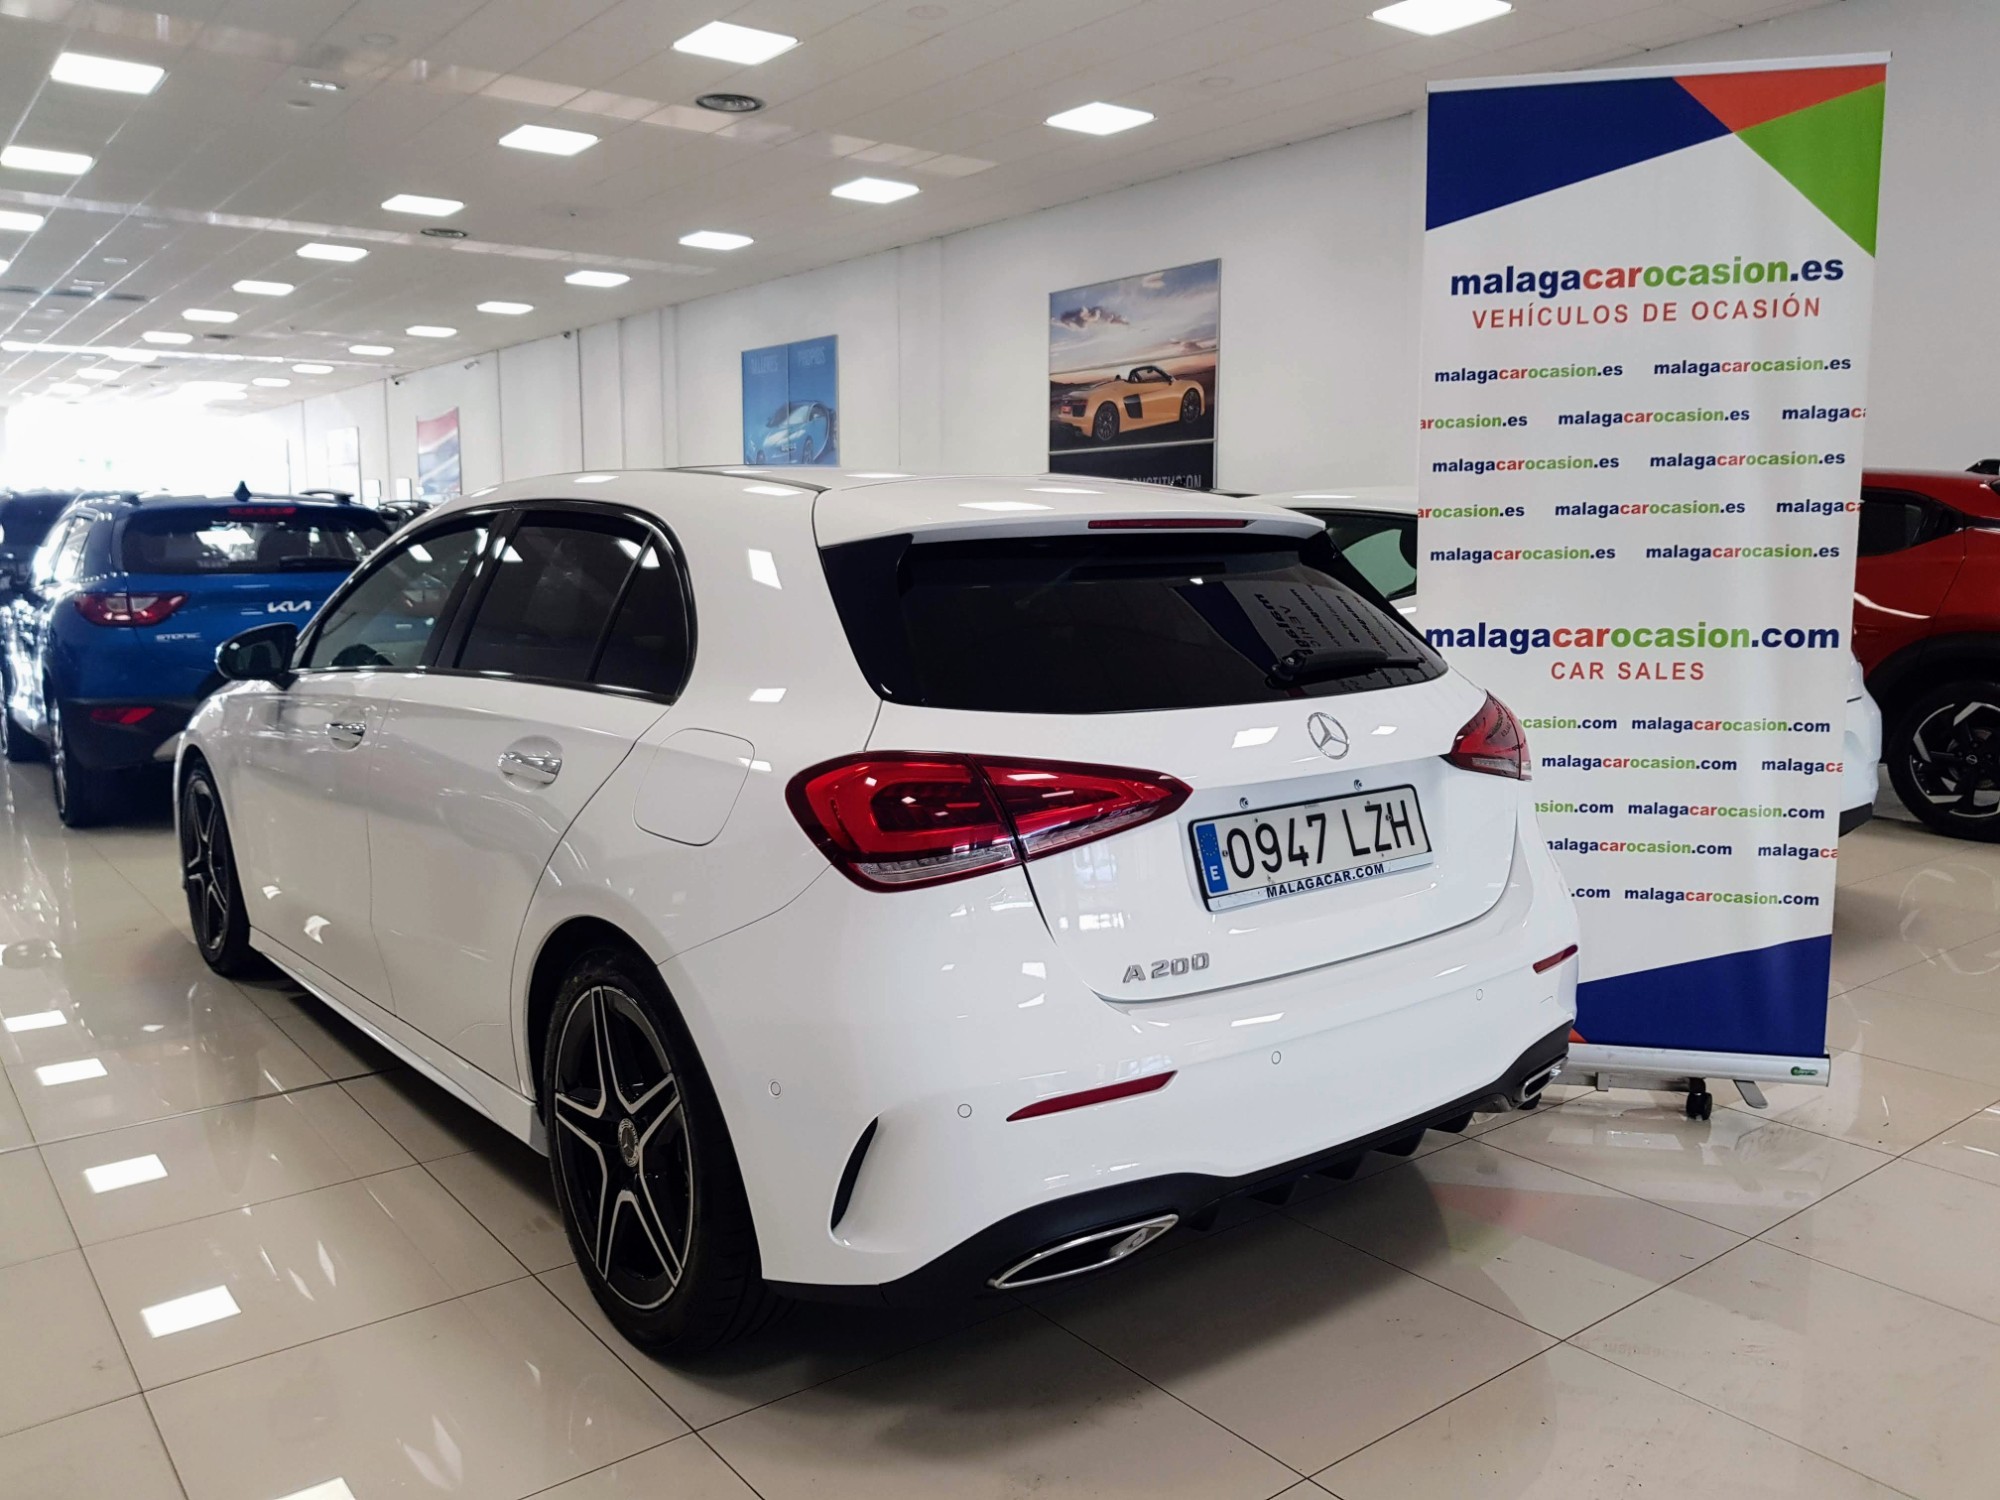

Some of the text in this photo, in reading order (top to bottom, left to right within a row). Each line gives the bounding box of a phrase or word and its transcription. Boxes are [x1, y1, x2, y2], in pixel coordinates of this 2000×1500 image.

[1451, 257, 1844, 297] malagacarocasion.es
[1473, 293, 1819, 329] VEHÍCULOS DE OCASIÓN
[1435, 357, 1851, 384] malagacarocasion.es malagacarocasion.es
[1558, 408, 1749, 427] malagacarocasion.es
[1433, 451, 1845, 475] malagacarocasion.es malagacarocasion.es
[1555, 500, 1745, 518] malagacarocasion.es
[1430, 544, 1839, 564] malagacarocasion.es malagacarocasion.es
[1426, 622, 1839, 653] malagacarocasion.com
[1551, 662, 1703, 680] CAR SALES
[1632, 717, 1830, 733] malagacarocasion.com
[1542, 755, 1737, 771] malagacarocasion.com
[1628, 802, 1825, 819] malagacarocasion.com
[1226, 800, 1415, 878] 0947 LZH
[1210, 866, 1219, 880] E
[1266, 864, 1385, 898] MALAGACAR.COM
[1625, 888, 1819, 906] malagacarocasion.com
[1122, 953, 1209, 983] A 200
